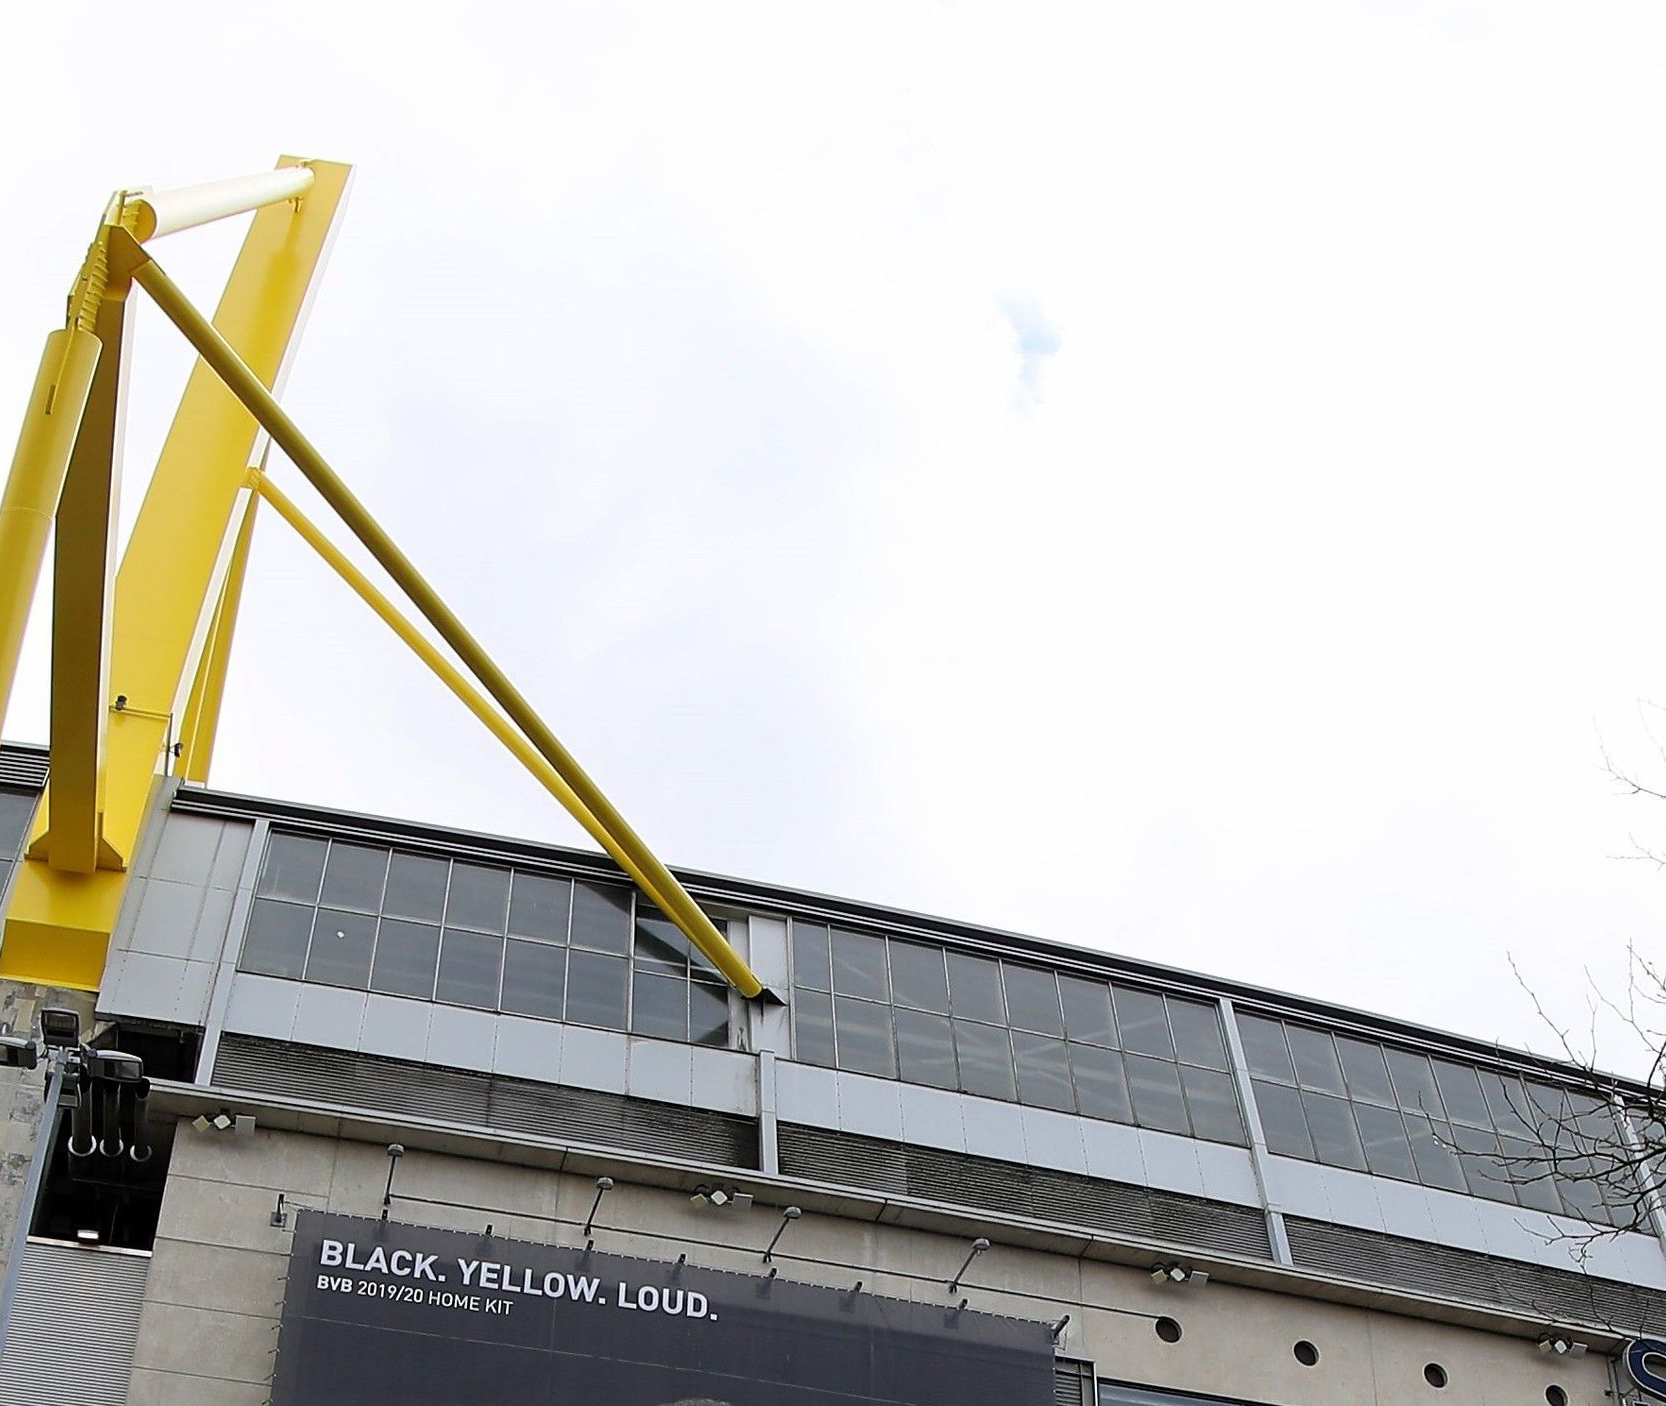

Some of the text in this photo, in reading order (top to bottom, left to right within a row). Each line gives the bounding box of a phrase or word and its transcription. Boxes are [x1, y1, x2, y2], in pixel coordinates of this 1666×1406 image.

[316, 1275, 514, 1316] BVB 2019/20 HOME KIT
[320, 1239, 719, 1321] BLACK. YELLOW. LOUD.
